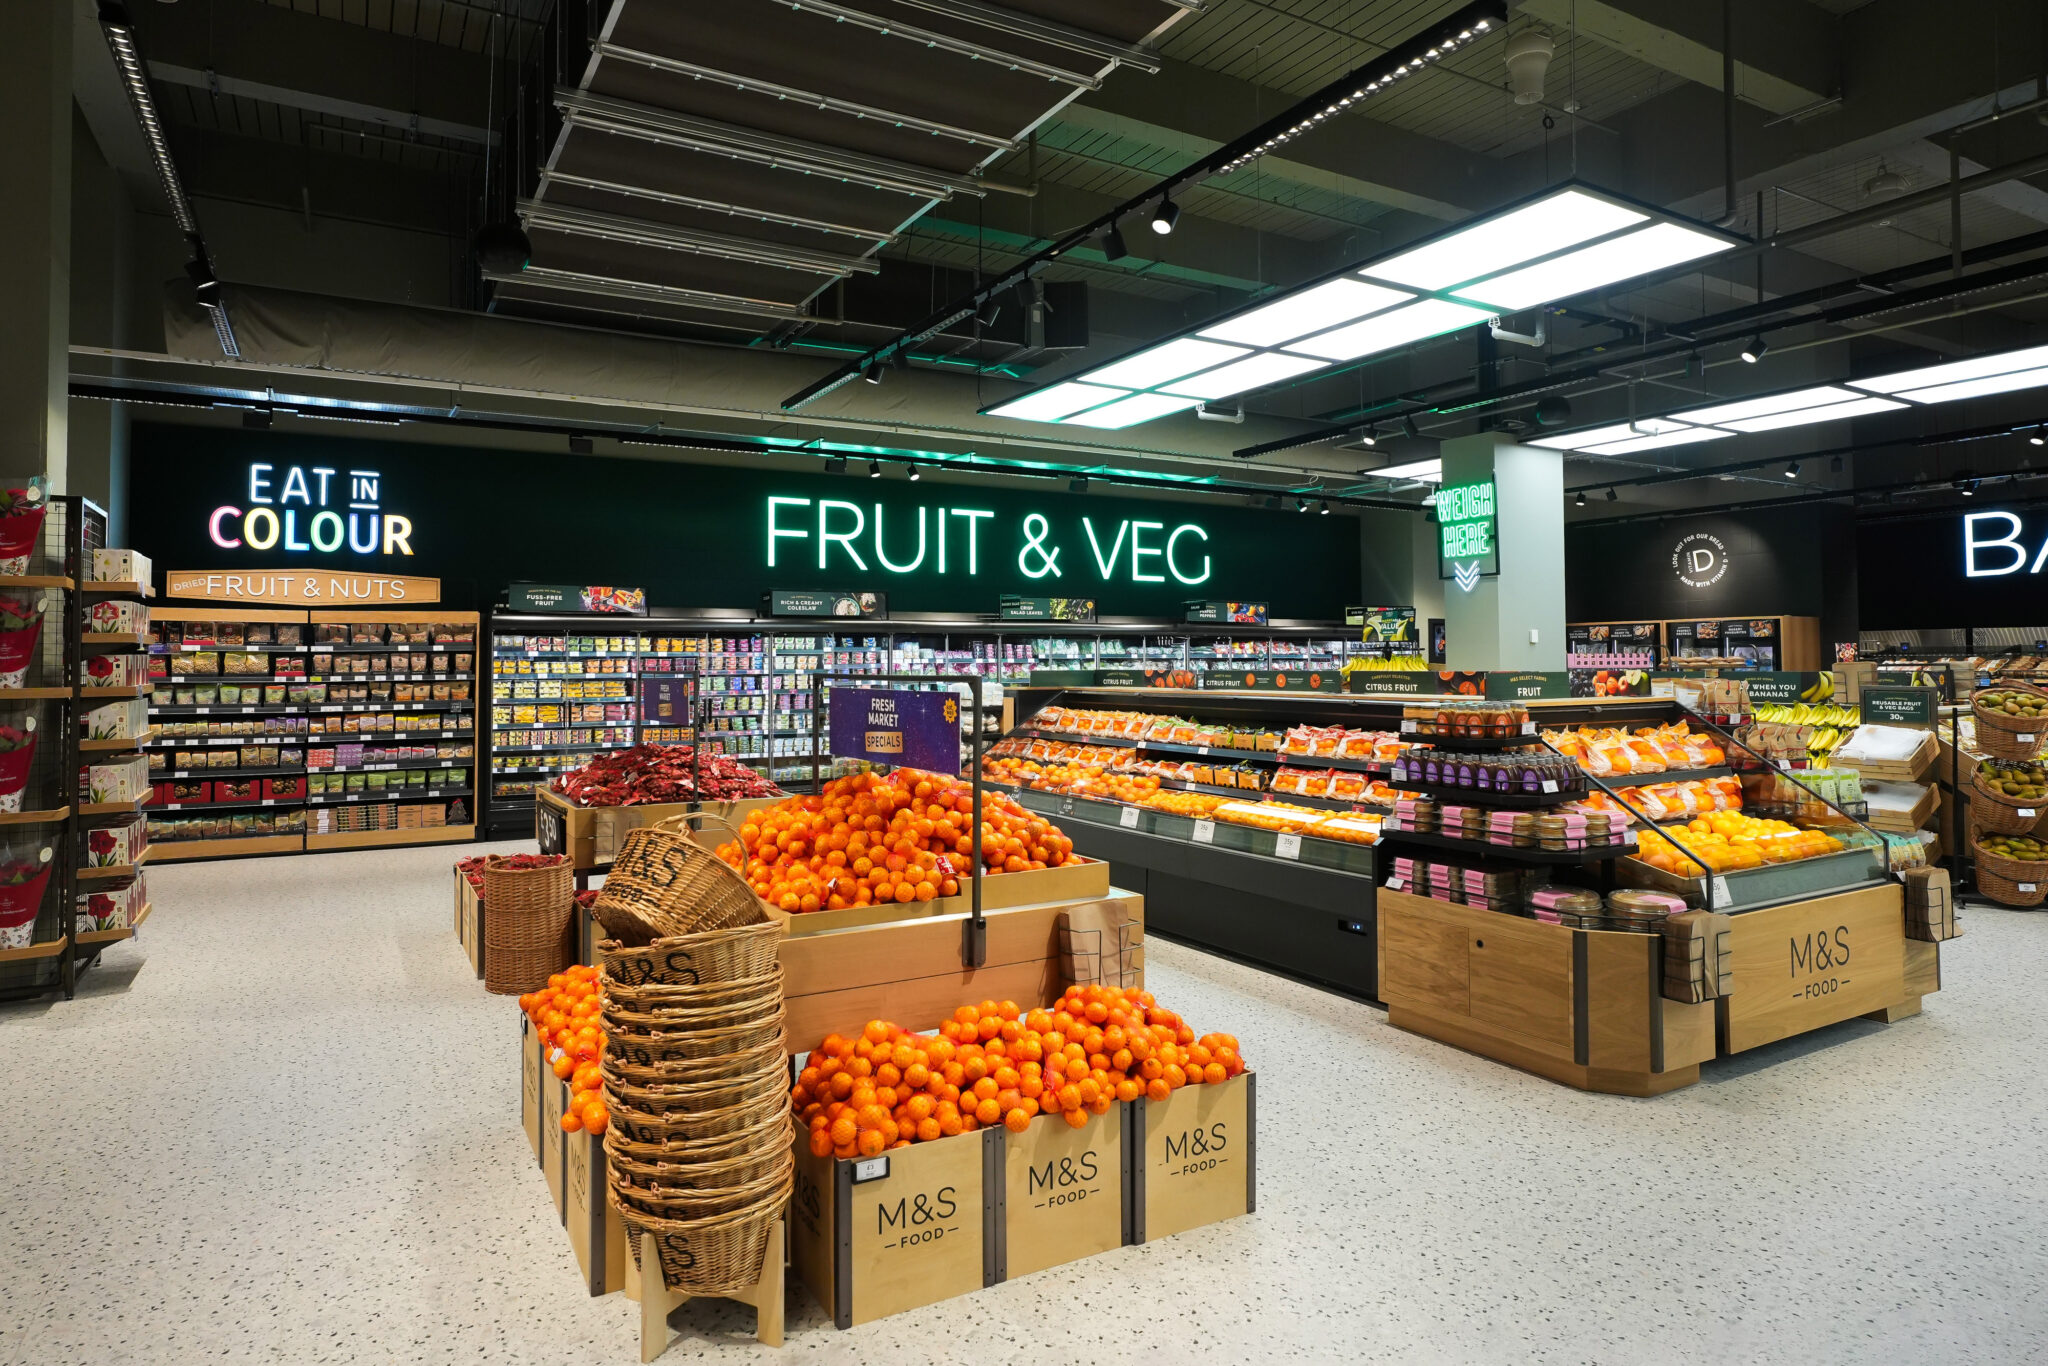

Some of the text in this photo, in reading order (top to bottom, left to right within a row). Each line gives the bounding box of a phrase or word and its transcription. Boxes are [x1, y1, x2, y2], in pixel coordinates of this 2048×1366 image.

[250, 463, 379, 506] EAT IN
[1436, 483, 1495, 522] WEIGH
[209, 505, 415, 556] COLOUR
[767, 496, 1211, 585] FRUIT & VEG
[1443, 521, 1491, 558] HERE
[1675, 541, 1685, 553] OUT
[1683, 534, 1695, 543] FOR
[1708, 535, 1724, 550] BREAD
[1692, 548, 1714, 573] D
[173, 575, 406, 599] DRIED FRUIT & NUTS
[1680, 575, 1694, 587] MADE
[1710, 564, 1728, 584] VITAMIN
[1365, 683, 1393, 691] CITRUS
[1517, 687, 1541, 696] FRUIT
[871, 698, 895, 712] FRESH
[868, 712, 899, 727] MARKET
[867, 735, 900, 748] SPECIALS
[1790, 925, 1850, 978] M&S
[1805, 978, 1838, 999] FOOD
[1164, 1122, 1227, 1164] M&S
[1028, 1150, 1098, 1195] M&S
[1182, 1158, 1218, 1176] FOOD
[1048, 1188, 1088, 1207] FOOD
[877, 1186, 957, 1235] M&S
[900, 1226, 944, 1248] FOOD
